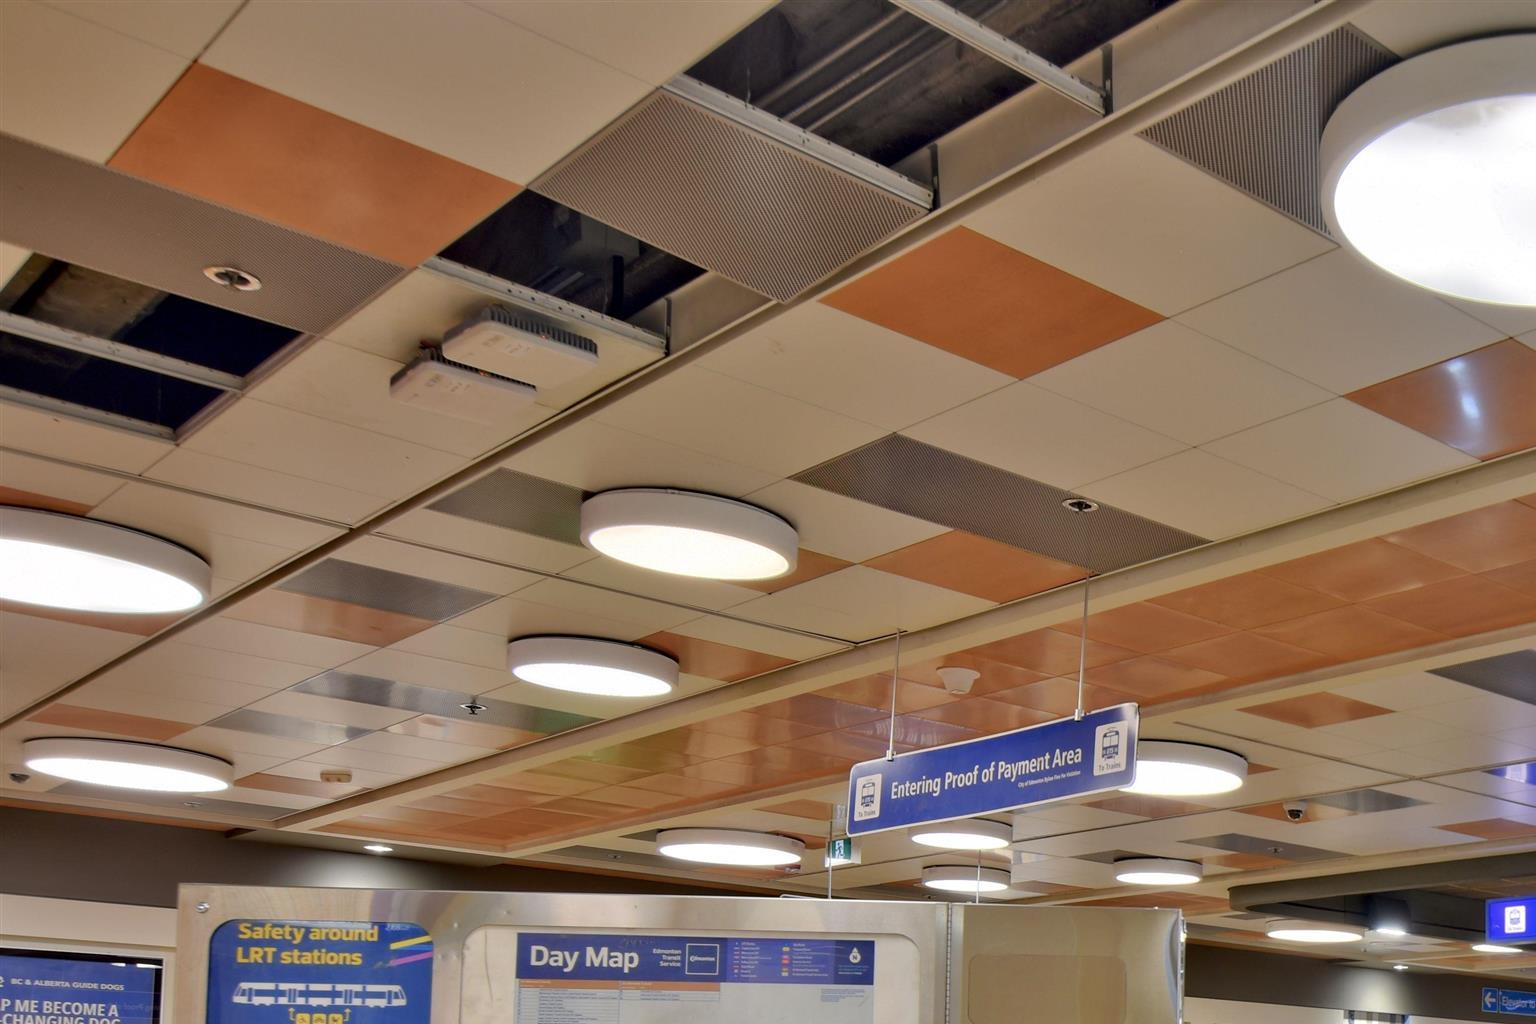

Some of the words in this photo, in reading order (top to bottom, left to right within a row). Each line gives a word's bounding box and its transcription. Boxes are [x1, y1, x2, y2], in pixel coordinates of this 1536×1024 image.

[891, 776, 941, 799] Entering
[944, 765, 979, 790] Proof
[981, 762, 995, 784] of
[998, 751, 1050, 782] Payment
[1052, 748, 1082, 769] Area
[238, 923, 305, 944] Safety
[309, 926, 379, 942] around
[236, 946, 277, 964] LRT
[280, 949, 363, 966] stations
[530, 945, 579, 972] Day
[585, 946, 639, 973] Map
[33, 980, 71, 988] ALBERTA
[72, 981, 99, 989] GUIDE
[100, 983, 125, 991] DOGS
[14, 999, 39, 1013] ME
[42, 1000, 105, 1016] BECOME
[108, 1004, 119, 1017] A
